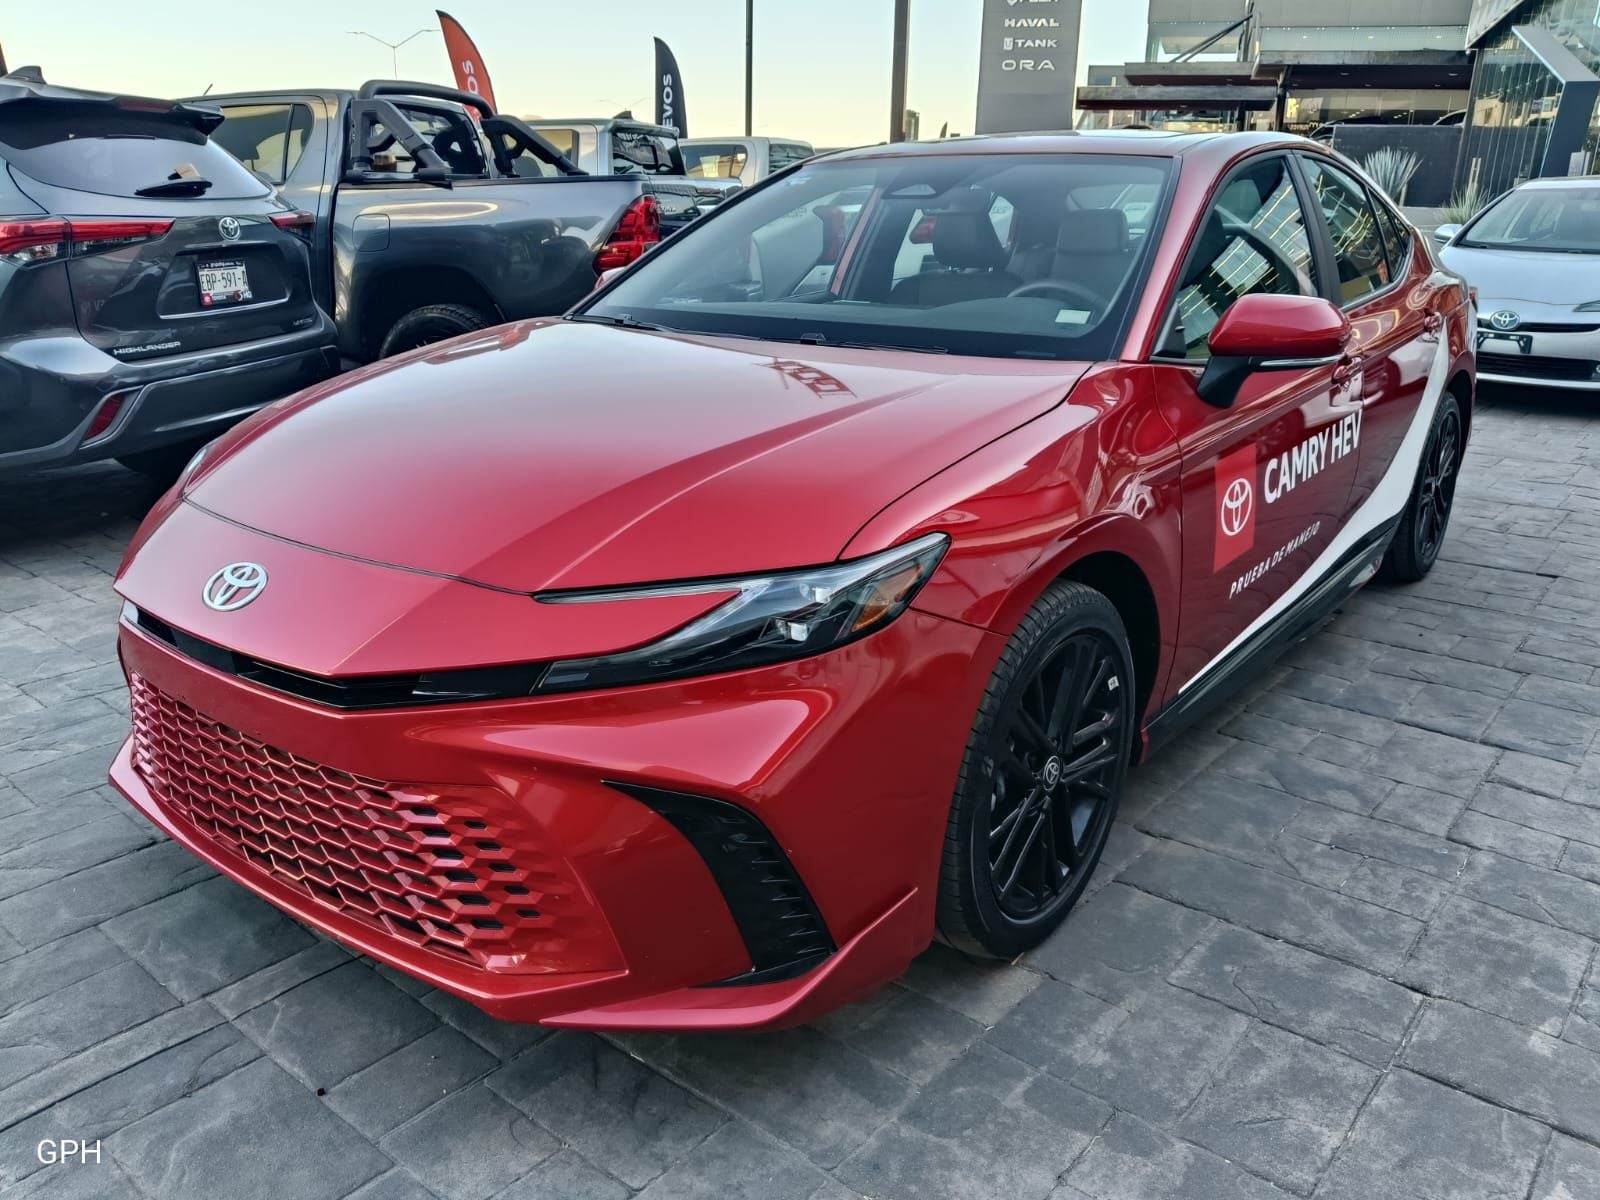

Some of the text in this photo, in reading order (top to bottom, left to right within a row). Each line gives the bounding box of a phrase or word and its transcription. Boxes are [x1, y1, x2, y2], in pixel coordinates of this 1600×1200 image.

[1004, 18, 1060, 28] HAVAL
[1015, 39, 1058, 48] TANK
[1001, 59, 1055, 71] ORA
[113, 341, 181, 355] HIGHLANDER
[1264, 408, 1363, 504] CAMRY HEV
[1229, 520, 1320, 600] PRUEBA DE MANEJO
